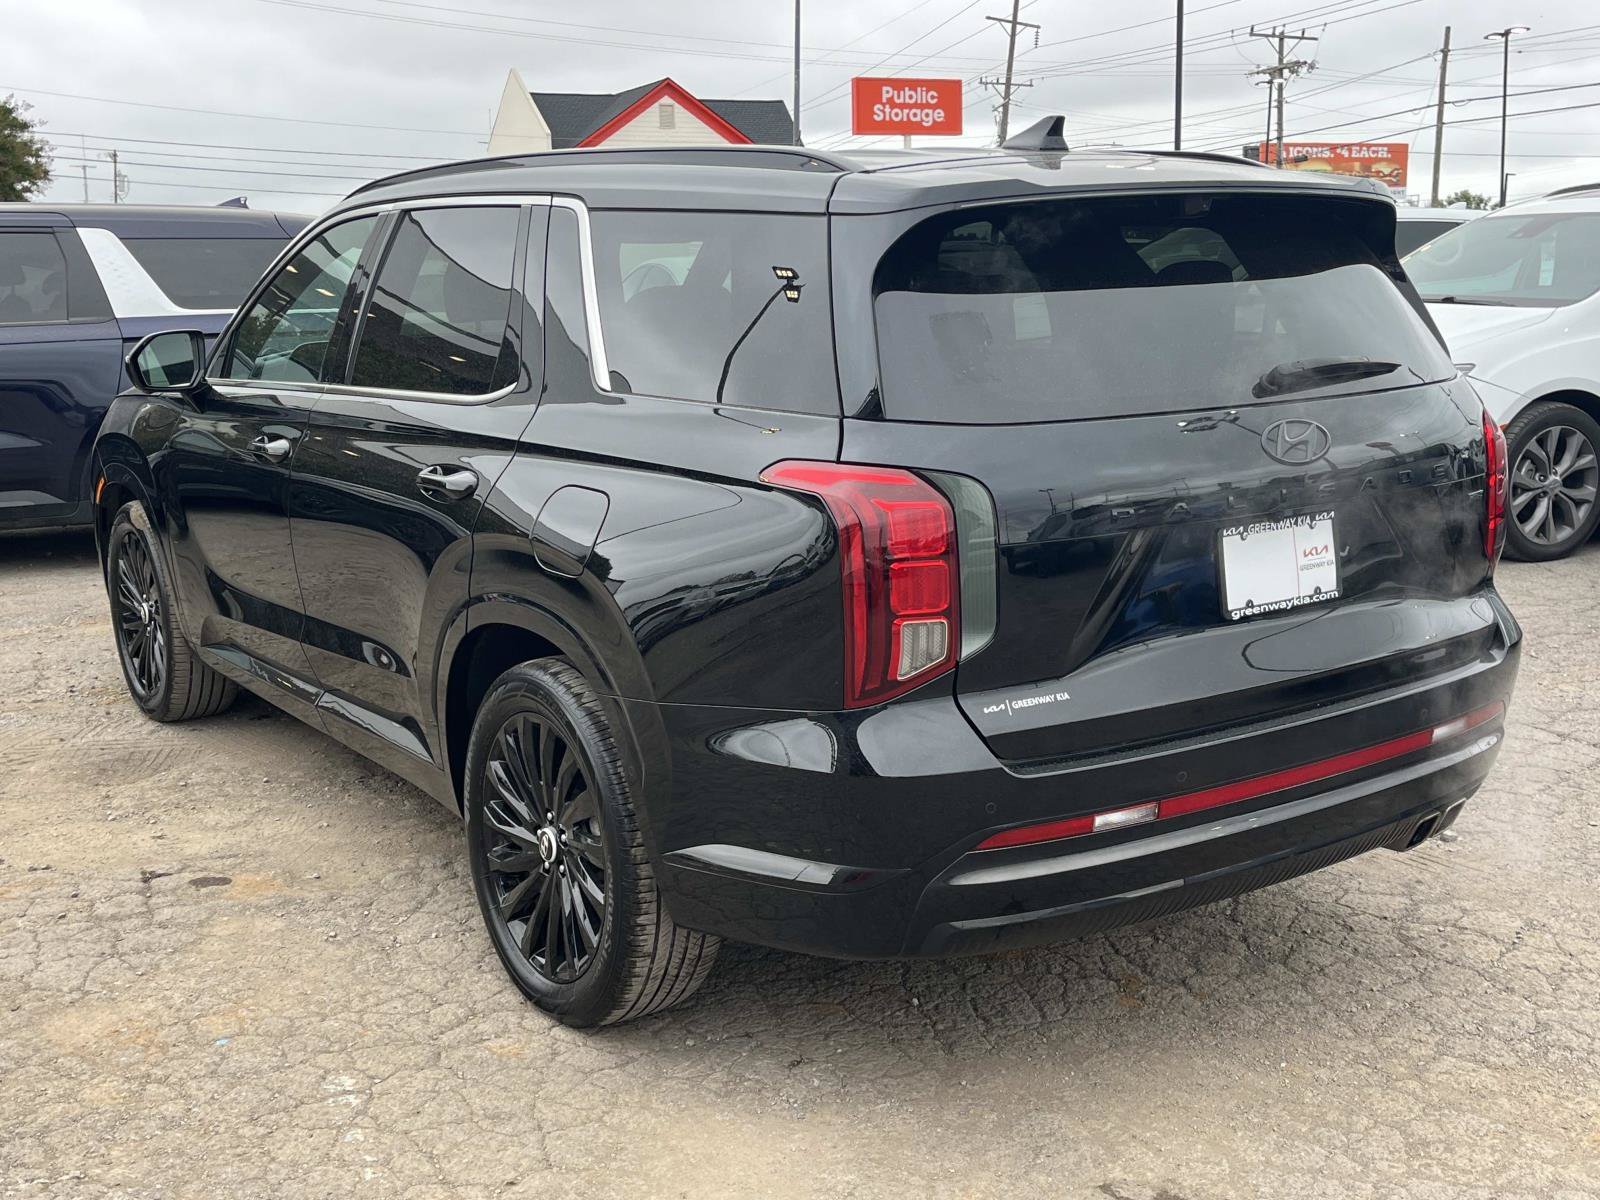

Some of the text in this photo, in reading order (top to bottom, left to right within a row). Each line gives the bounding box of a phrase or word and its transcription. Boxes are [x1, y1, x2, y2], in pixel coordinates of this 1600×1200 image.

[882, 86, 938, 104] Public
[873, 103, 944, 127] Storage
[1351, 147, 1391, 159] EACH.
[1247, 517, 1296, 535] GREENWAY
[1297, 515, 1311, 528] KIA
[1303, 544, 1329, 558] KIA
[1300, 561, 1326, 572] GREENWAY
[1231, 590, 1339, 620] greenwaykia.com
[1011, 694, 1055, 709] GREENWAY
[1055, 692, 1071, 702] KIA
